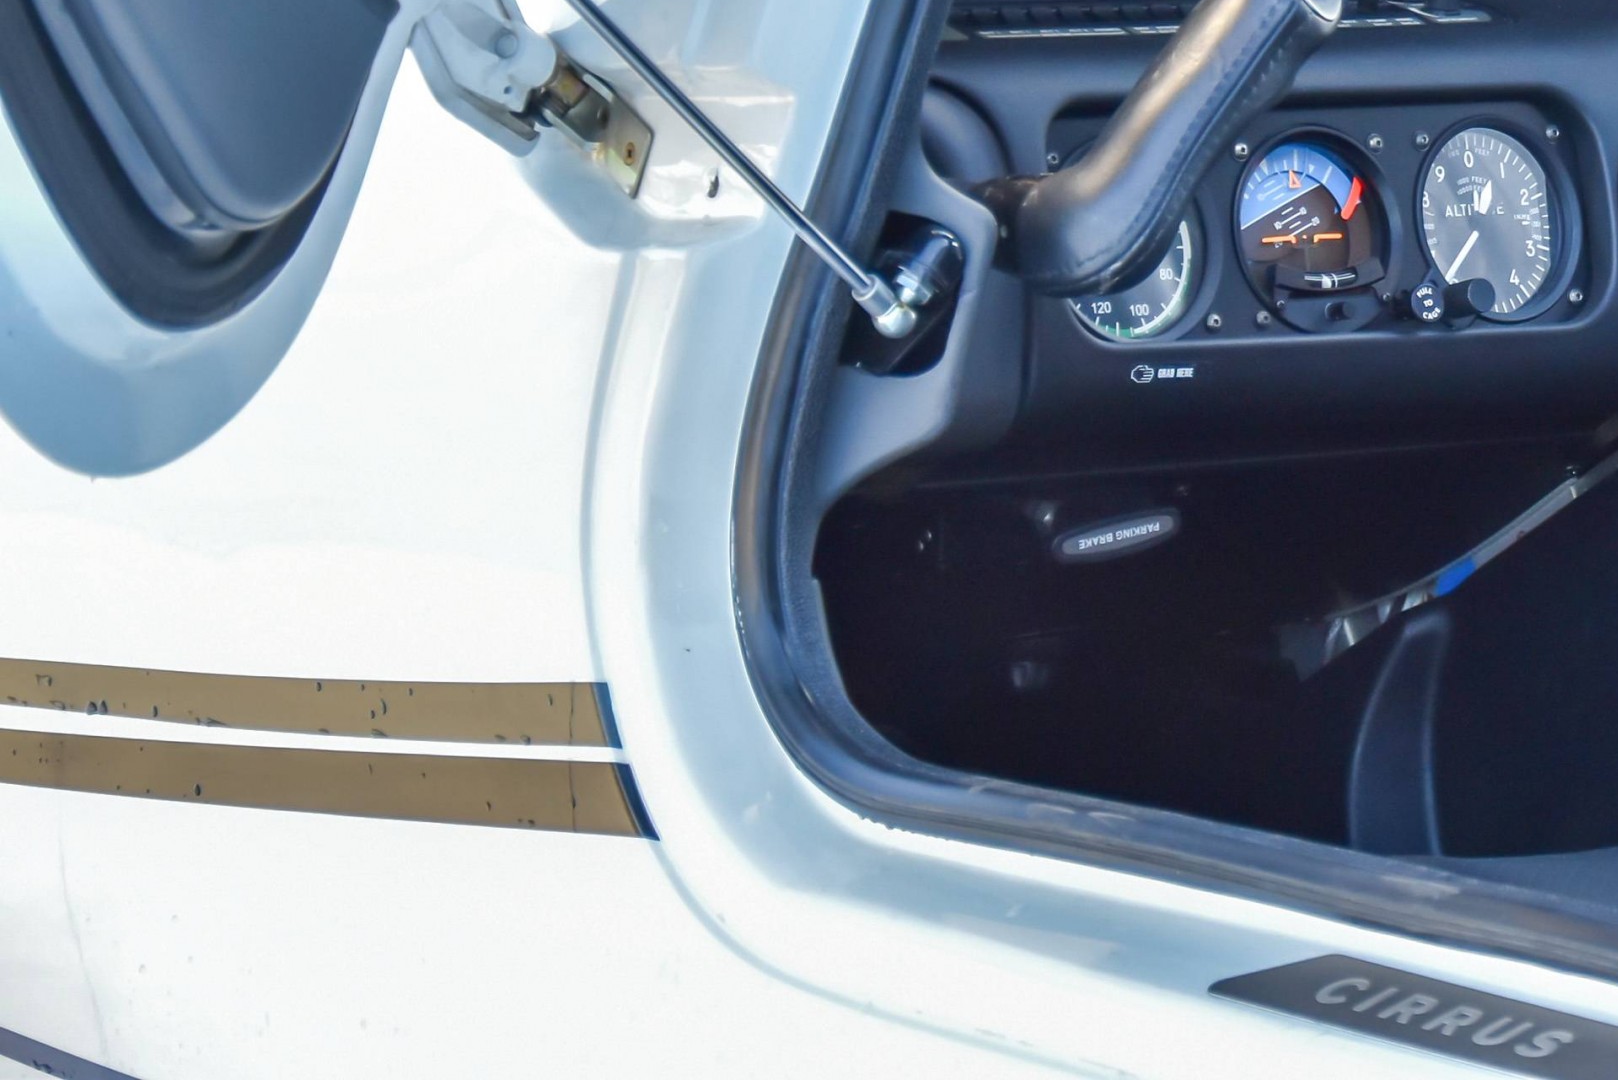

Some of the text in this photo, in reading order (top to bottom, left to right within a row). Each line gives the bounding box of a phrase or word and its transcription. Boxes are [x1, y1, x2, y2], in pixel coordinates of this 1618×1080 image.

[1463, 151, 1474, 168] 0
[1474, 148, 1490, 156] FEET
[1435, 165, 1445, 183] 9
[1499, 162, 1505, 179] 1
[1422, 191, 1430, 208] 8
[1520, 188, 1530, 206] 2
[1445, 203, 1505, 218] ALTIE
[1525, 240, 1536, 257] 3
[1159, 268, 1173, 280] 80
[1509, 269, 1520, 286] 4
[1416, 286, 1433, 298] PULL
[1091, 301, 1112, 314] 120
[1129, 303, 1150, 316] 100
[1423, 299, 1433, 307] TO
[1422, 307, 1441, 320] CAGE
[1176, 367, 1194, 378] HERE
[1078, 521, 1160, 550] PARKING BRAKE
[1313, 977, 1575, 1059] CIRRUS
